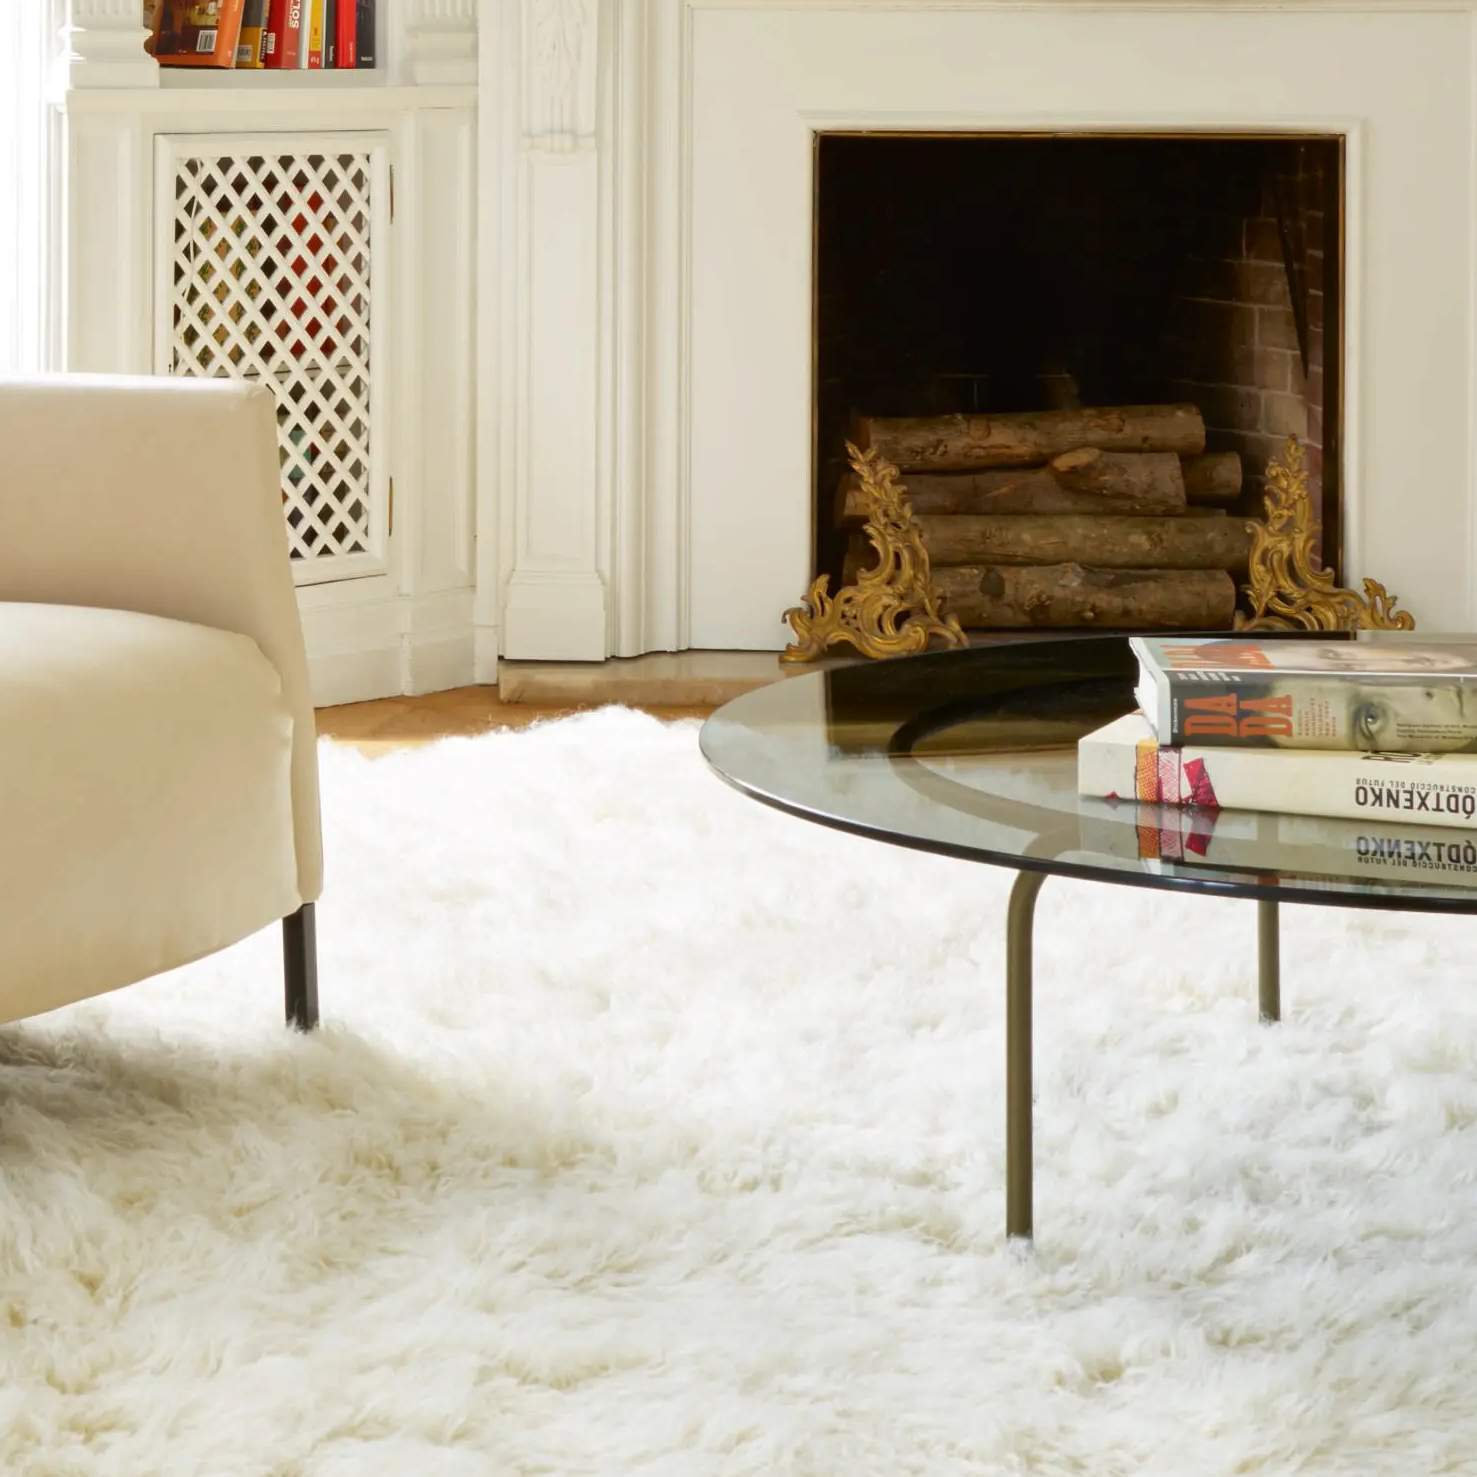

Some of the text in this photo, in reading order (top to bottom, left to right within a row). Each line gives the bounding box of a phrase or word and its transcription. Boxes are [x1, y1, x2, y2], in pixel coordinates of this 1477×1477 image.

[1184, 692, 1238, 737] DA
[1239, 694, 1293, 738] DA
[1355, 777, 1385, 787] FUTUR
[1389, 780, 1406, 789] DEL
